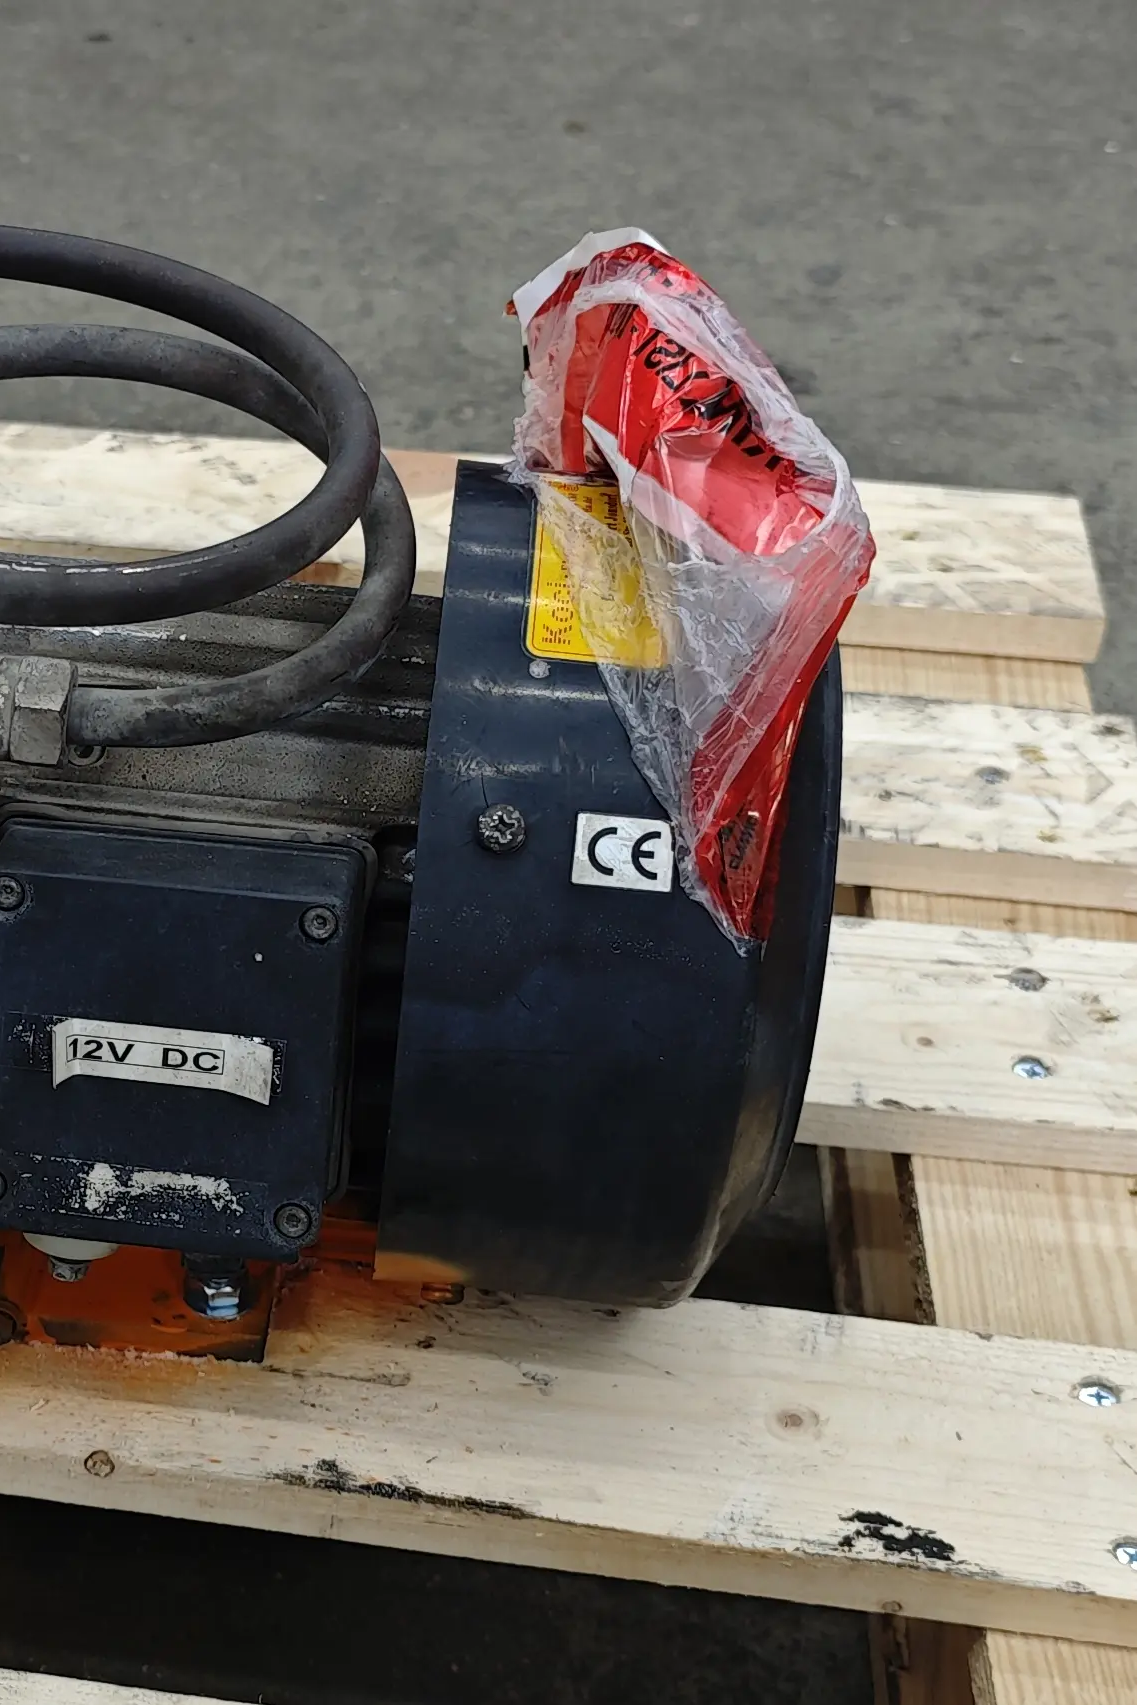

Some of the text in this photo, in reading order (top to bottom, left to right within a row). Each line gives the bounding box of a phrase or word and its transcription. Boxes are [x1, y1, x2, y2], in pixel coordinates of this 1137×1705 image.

[588, 827, 661, 880] CE
[68, 1038, 221, 1072] 12V DC
